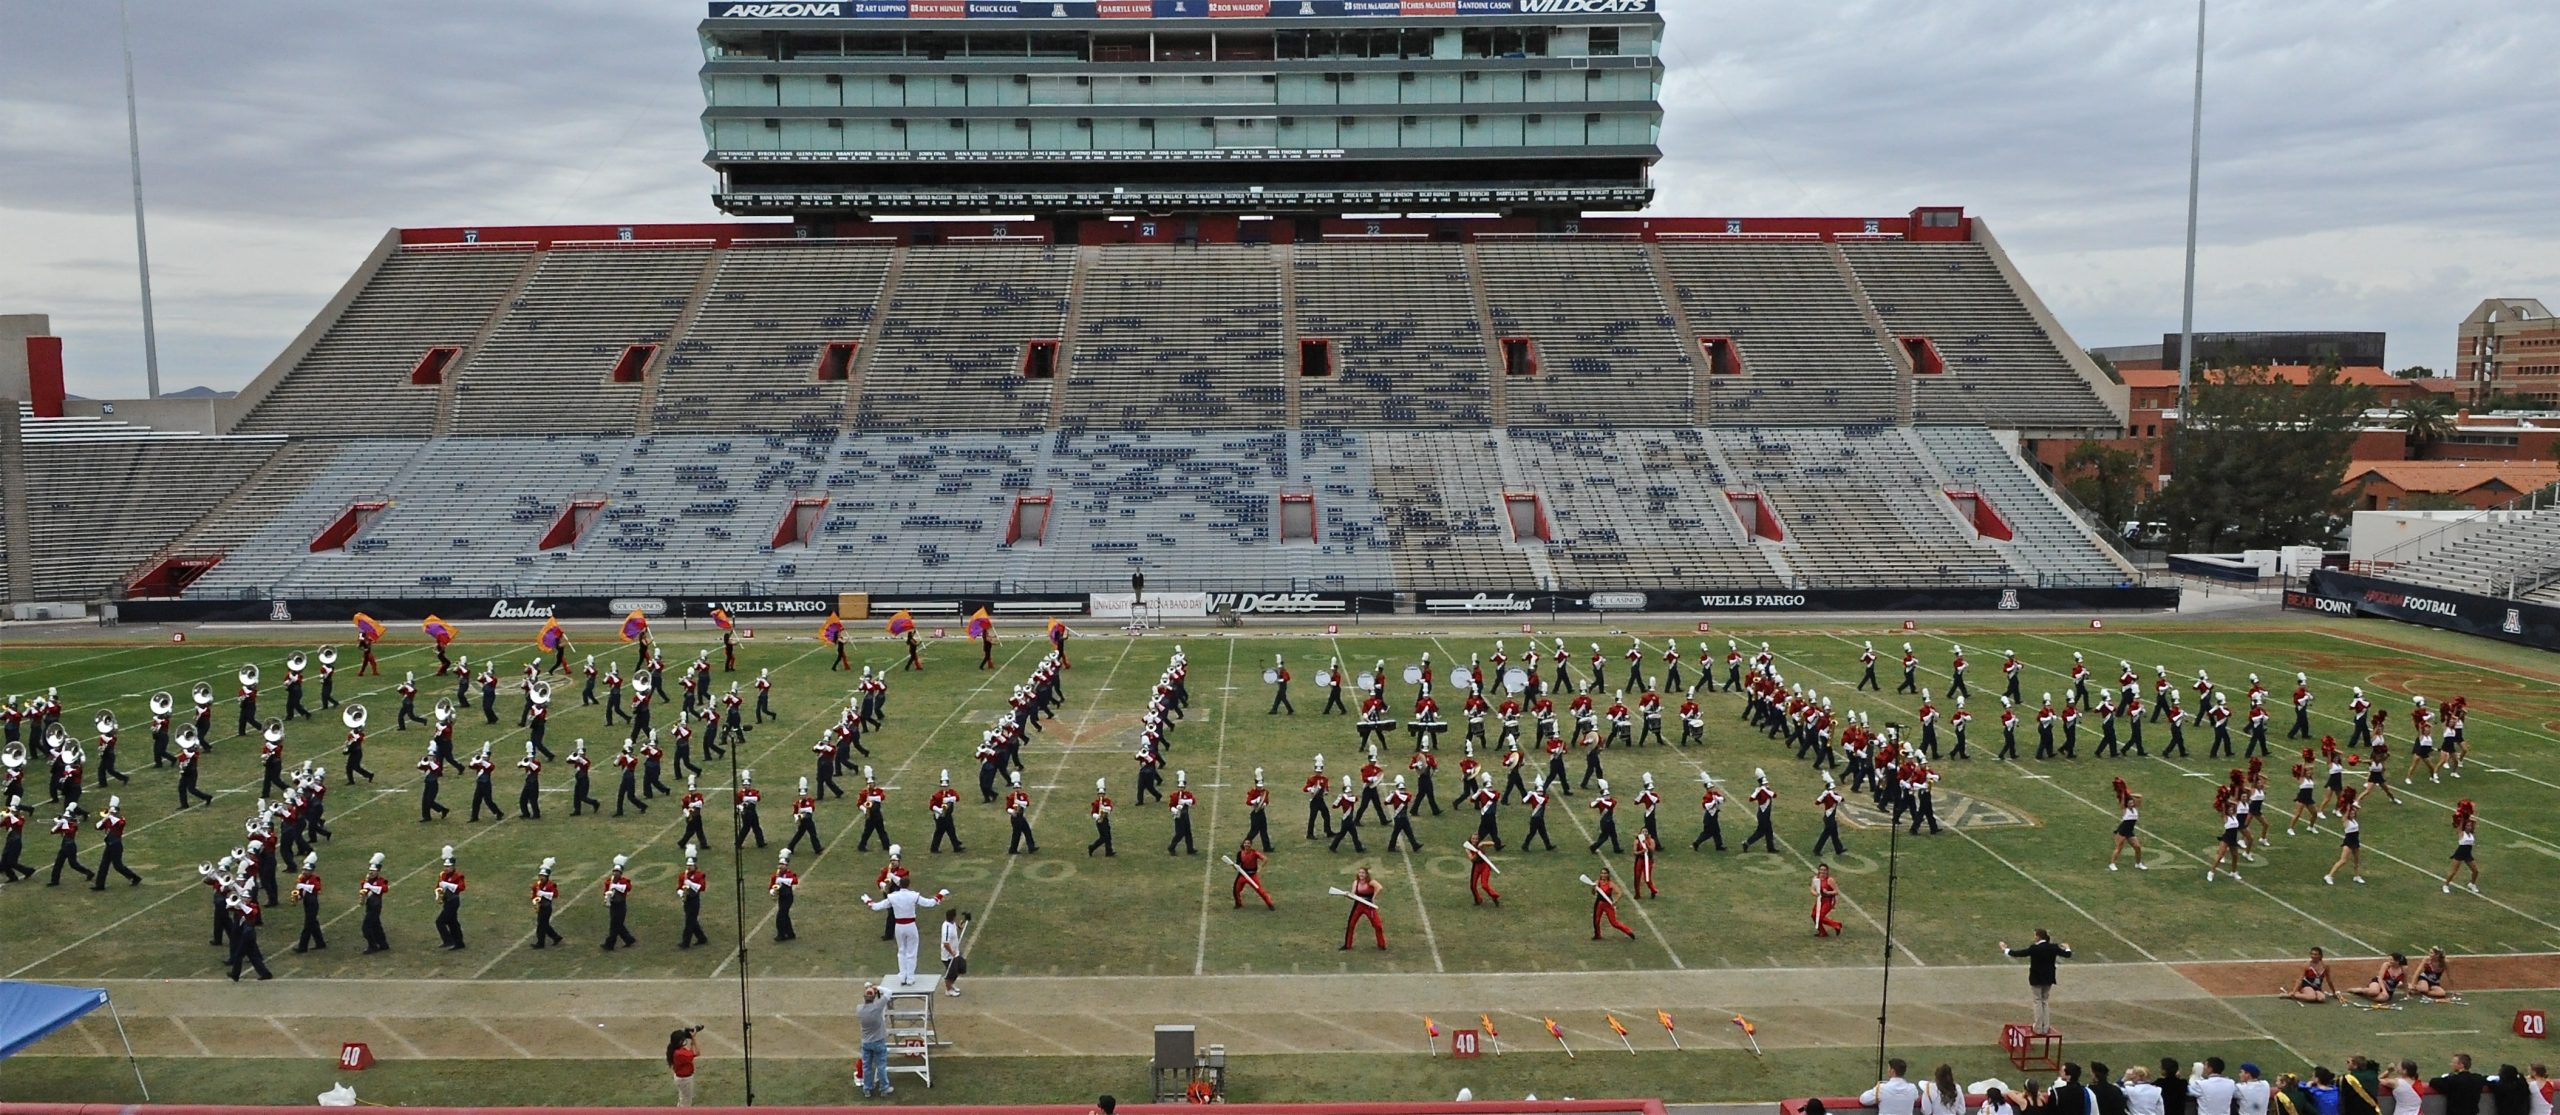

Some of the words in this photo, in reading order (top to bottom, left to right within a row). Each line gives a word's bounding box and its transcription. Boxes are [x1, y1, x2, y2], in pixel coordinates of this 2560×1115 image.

[856, 5, 864, 13] 22
[865, 5, 878, 13] ART
[878, 5, 907, 13] LUPPINO
[919, 5, 939, 13] RICKY
[940, 5, 965, 13] HUNLEY
[976, 5, 999, 13] CHUCK
[1000, 5, 1019, 13] CECIL
[1132, 4, 1152, 13] LEWIS
[1233, 3, 1264, 12] WALDROP
[1407, 1, 1425, 9] CHRIS
[1462, 1, 1489, 9] ANTOINE
[1490, 1, 1511, 9] CASON
[1520, 0, 1648, 12] WILDCATS
[723, 4, 841, 17] ARIZONA
[993, 228, 1007, 237] 20
[1143, 226, 1154, 236] 21
[1367, 225, 1380, 234] 22
[1566, 224, 1578, 233] 23
[1727, 224, 1740, 233] 24
[1865, 224, 1878, 233] 25
[466, 234, 476, 243] 17
[619, 232, 631, 241] 18
[796, 230, 807, 239] 19
[103, 404, 114, 413] 16
[1093, 600, 1128, 610] UNIVERSITY
[1169, 599, 1189, 609] BAND
[1189, 599, 1203, 609] DAY
[1701, 595, 1754, 606] WELLS
[1755, 595, 1805, 606] FARGO
[489, 599, 556, 618] Bashas'
[721, 601, 773, 612] WELLS
[777, 601, 827, 612] FARGO
[2402, 596, 2457, 617] FOOTBALL
[2523, 1014, 2543, 1034] 20
[1456, 1034, 1475, 1053] 40
[342, 1046, 361, 1066] 40
